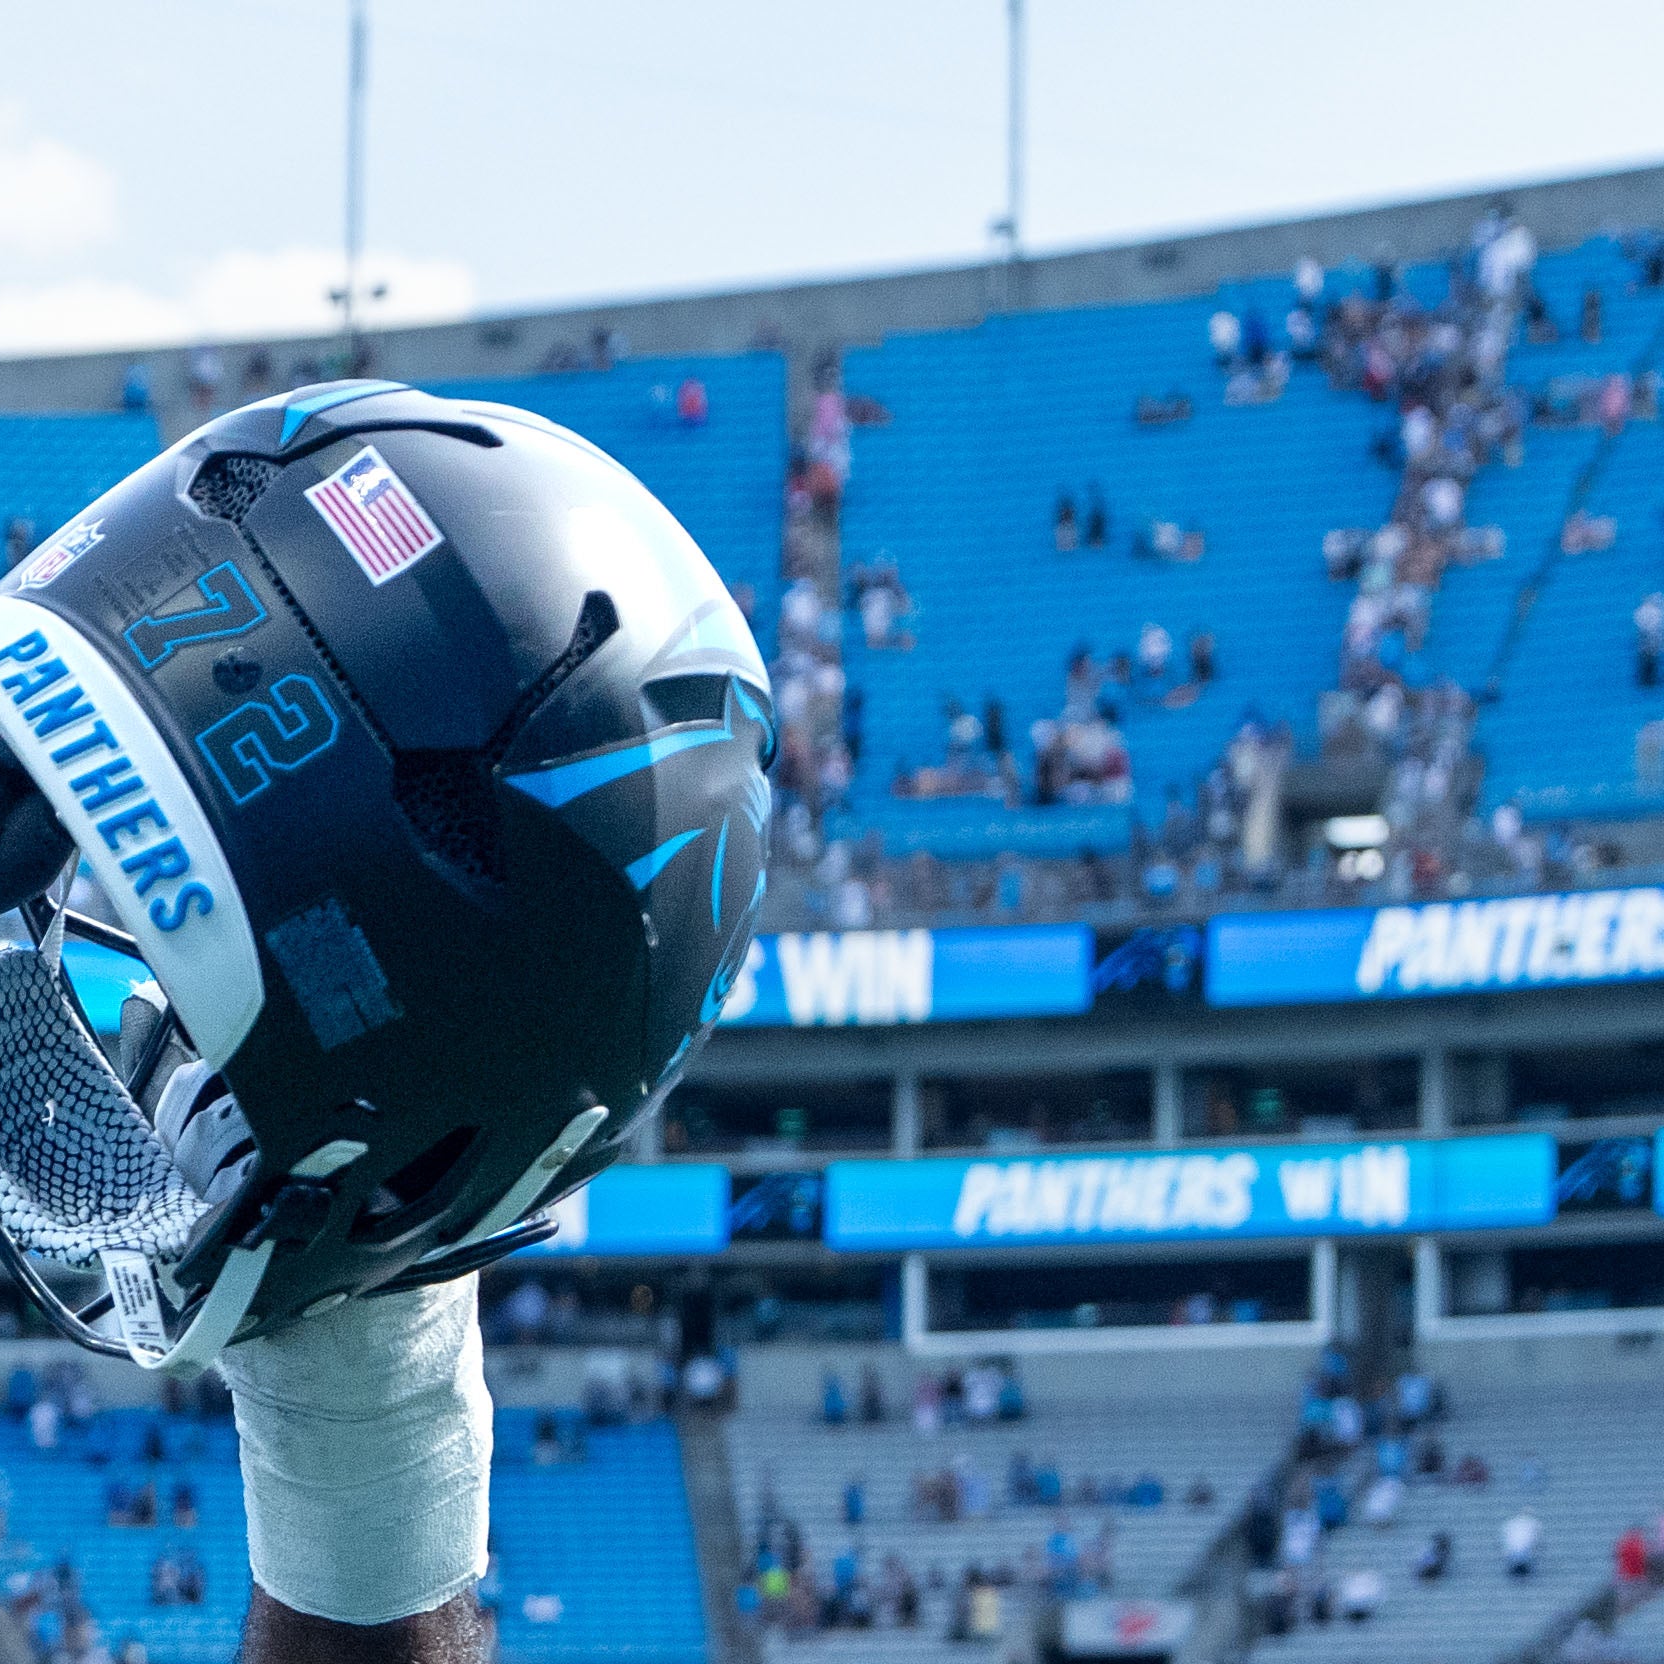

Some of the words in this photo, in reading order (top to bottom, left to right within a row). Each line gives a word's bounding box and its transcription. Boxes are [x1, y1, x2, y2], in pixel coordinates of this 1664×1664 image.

[123, 559, 341, 804] 72
[776, 927, 934, 1026] WIN
[953, 1152, 1259, 1237] PANTHERS
[1277, 1144, 1411, 1227] WIN
